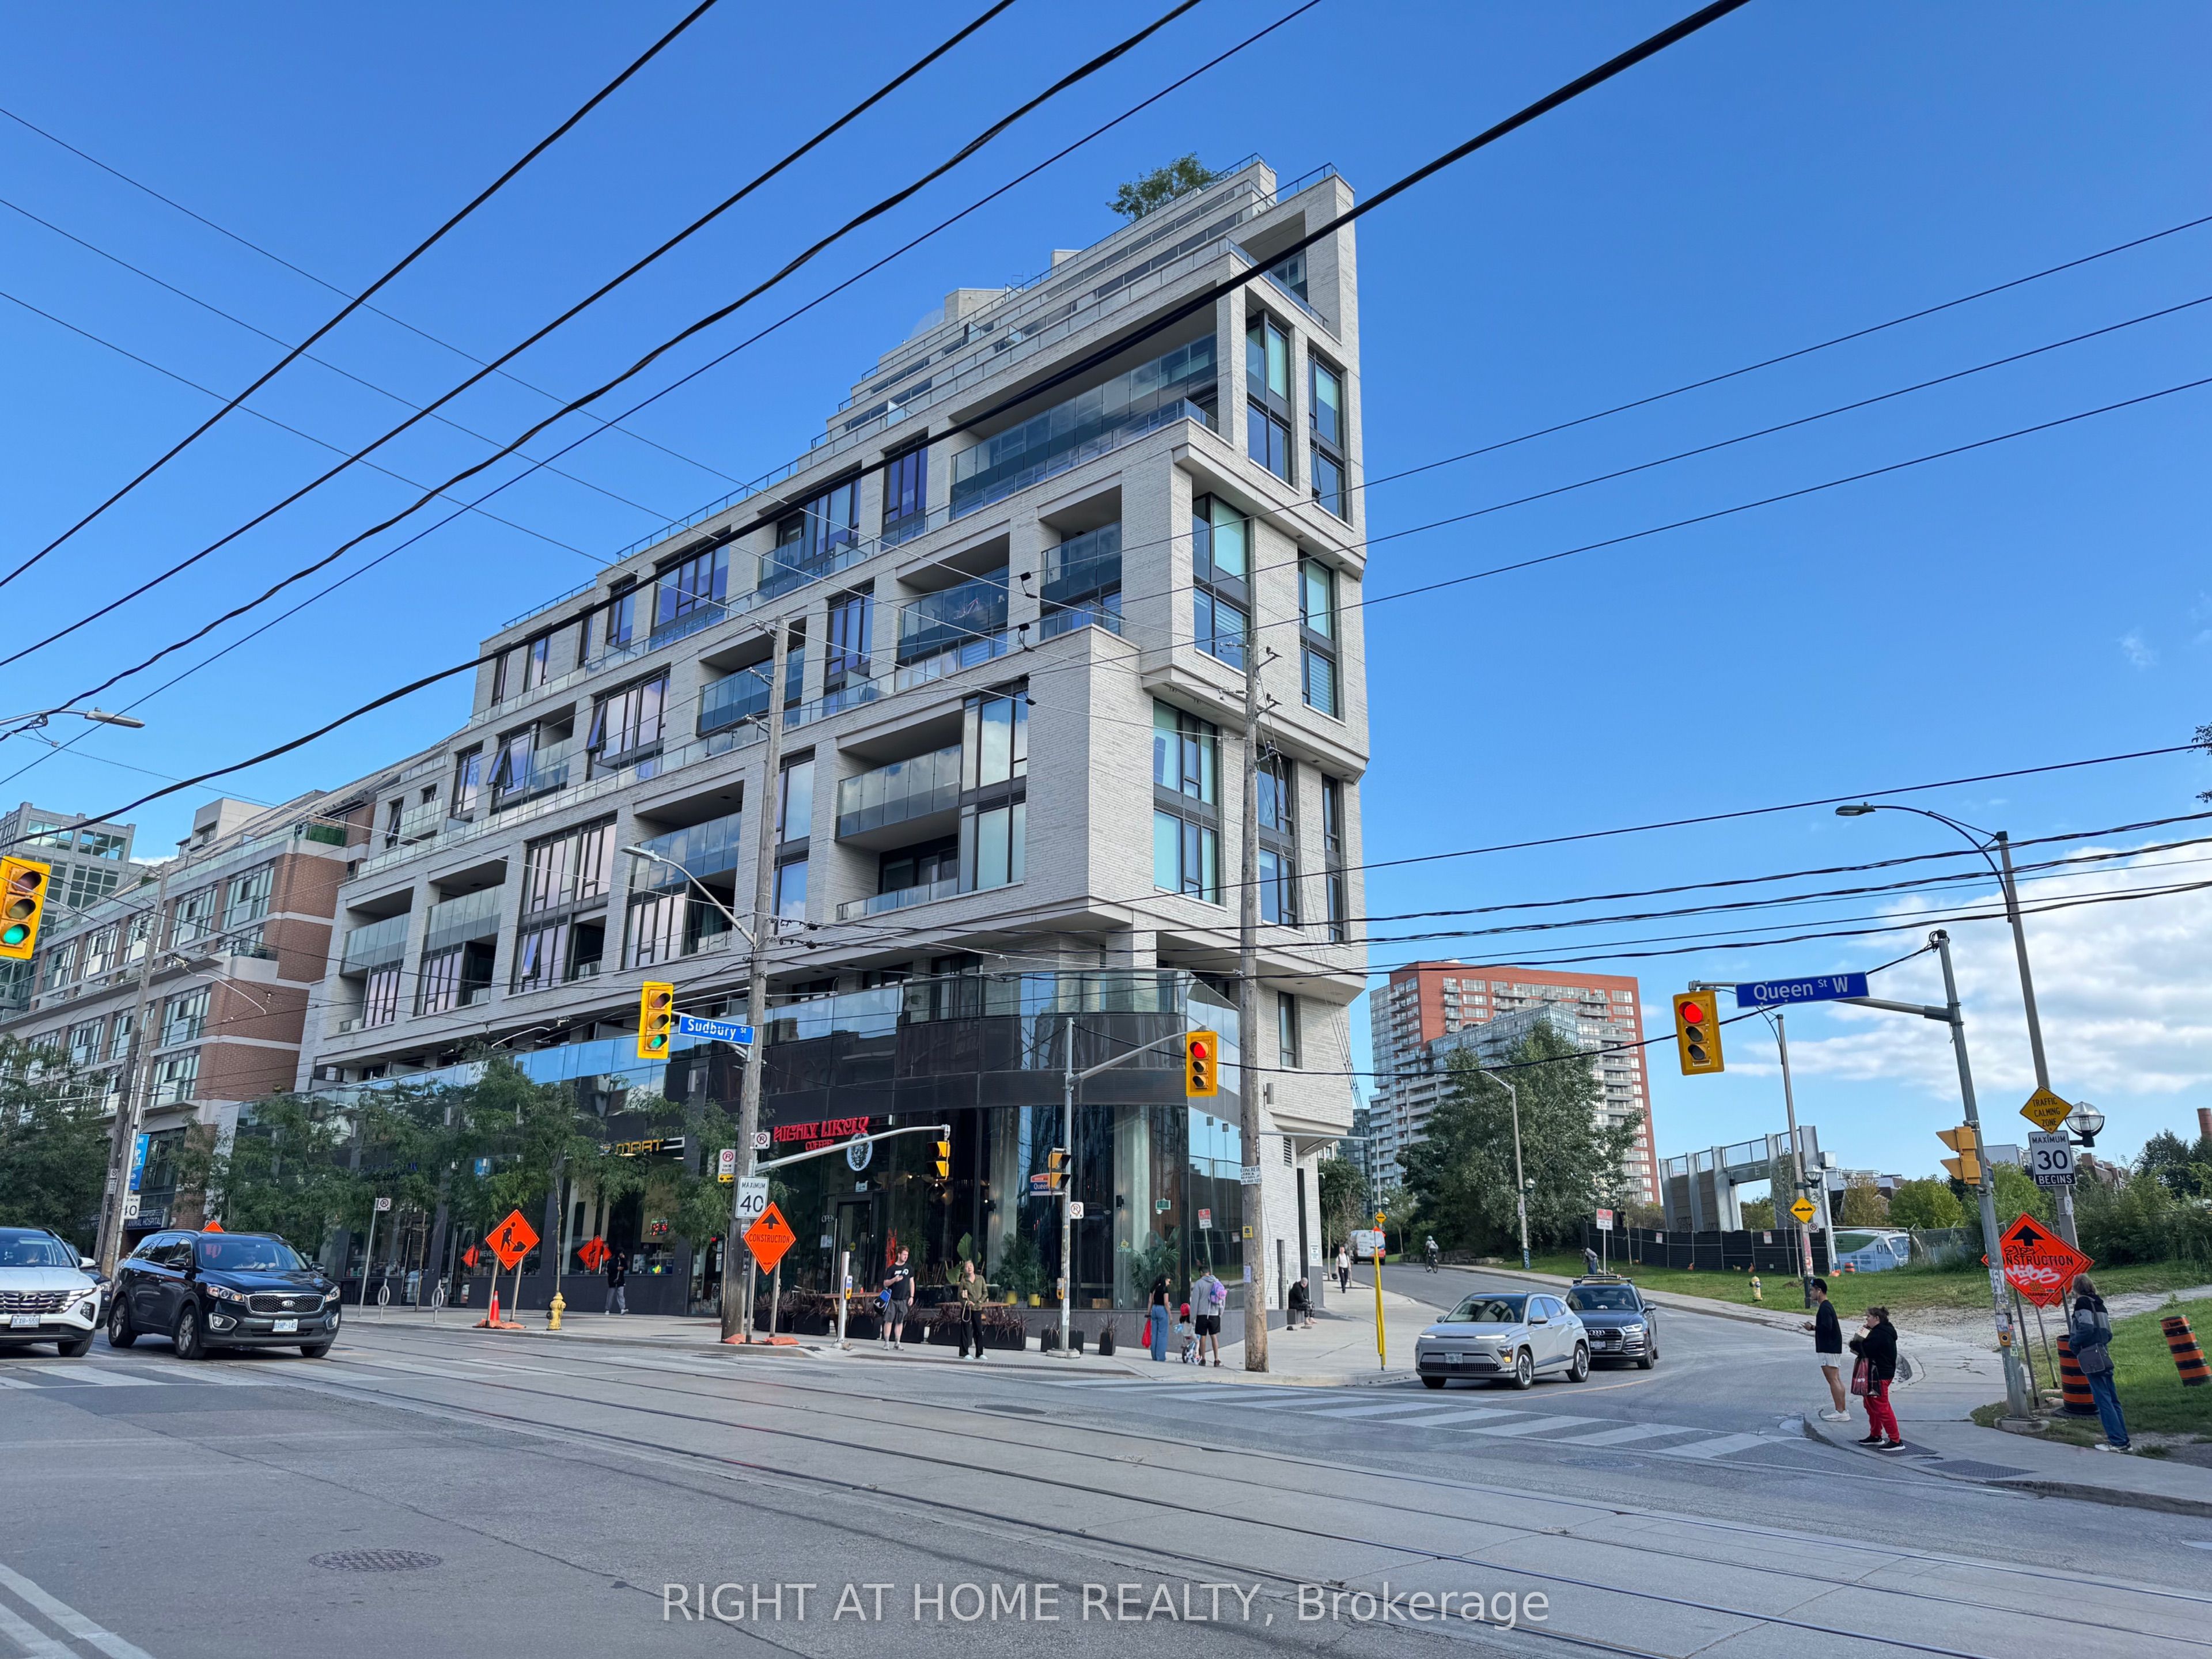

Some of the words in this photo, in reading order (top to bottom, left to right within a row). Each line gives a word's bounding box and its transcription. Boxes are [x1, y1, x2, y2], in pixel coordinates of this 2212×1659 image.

[1753, 984, 1813, 1001] Queen
[1818, 979, 1828, 987] St
[1832, 976, 1848, 993] W
[687, 1019, 736, 1040] Sudbury
[2032, 1097, 2058, 1107] TRAFFIC
[2034, 1107, 2061, 1117] CALMING
[2041, 1118, 2057, 1127] ZONE
[774, 1123, 819, 1142] HIGHLY
[821, 1116, 869, 1138] LIKELY
[2032, 1135, 2066, 1144] MAXIMUM
[2037, 1150, 2068, 1170] 30
[2039, 1175, 2073, 1184] BEGINS
[740, 1195, 764, 1213] 40
[749, 1234, 790, 1244] CONSTRUCTION
[2003, 1255, 2074, 1266] NSTRUCTION
